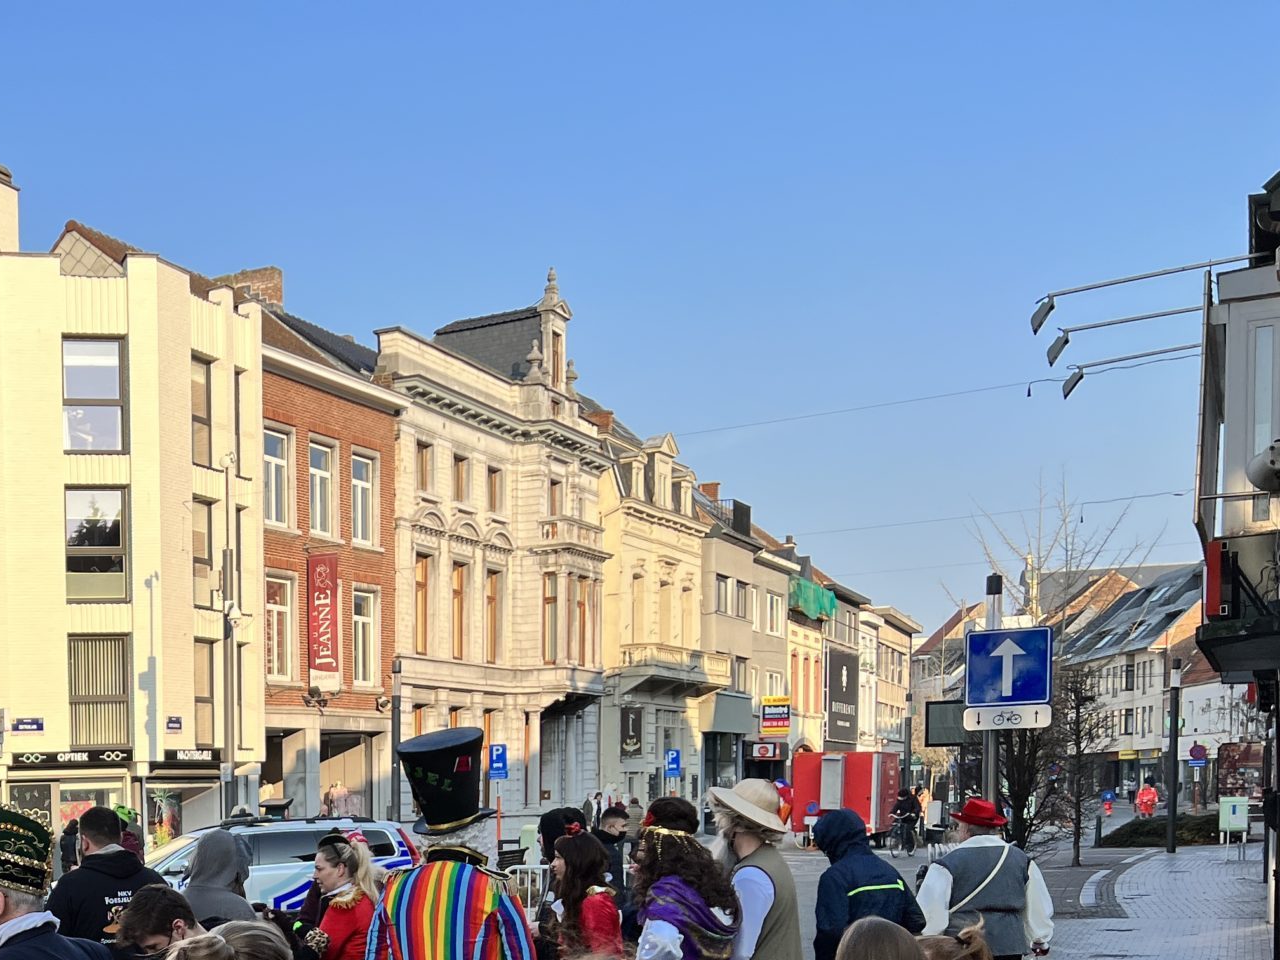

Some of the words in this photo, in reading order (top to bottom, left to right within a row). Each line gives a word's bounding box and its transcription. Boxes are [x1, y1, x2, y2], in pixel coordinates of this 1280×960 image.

[314, 589, 337, 668] JEANNE
[57, 752, 89, 762] OPTIEK
[493, 746, 503, 760] P
[668, 751, 677, 762] P
